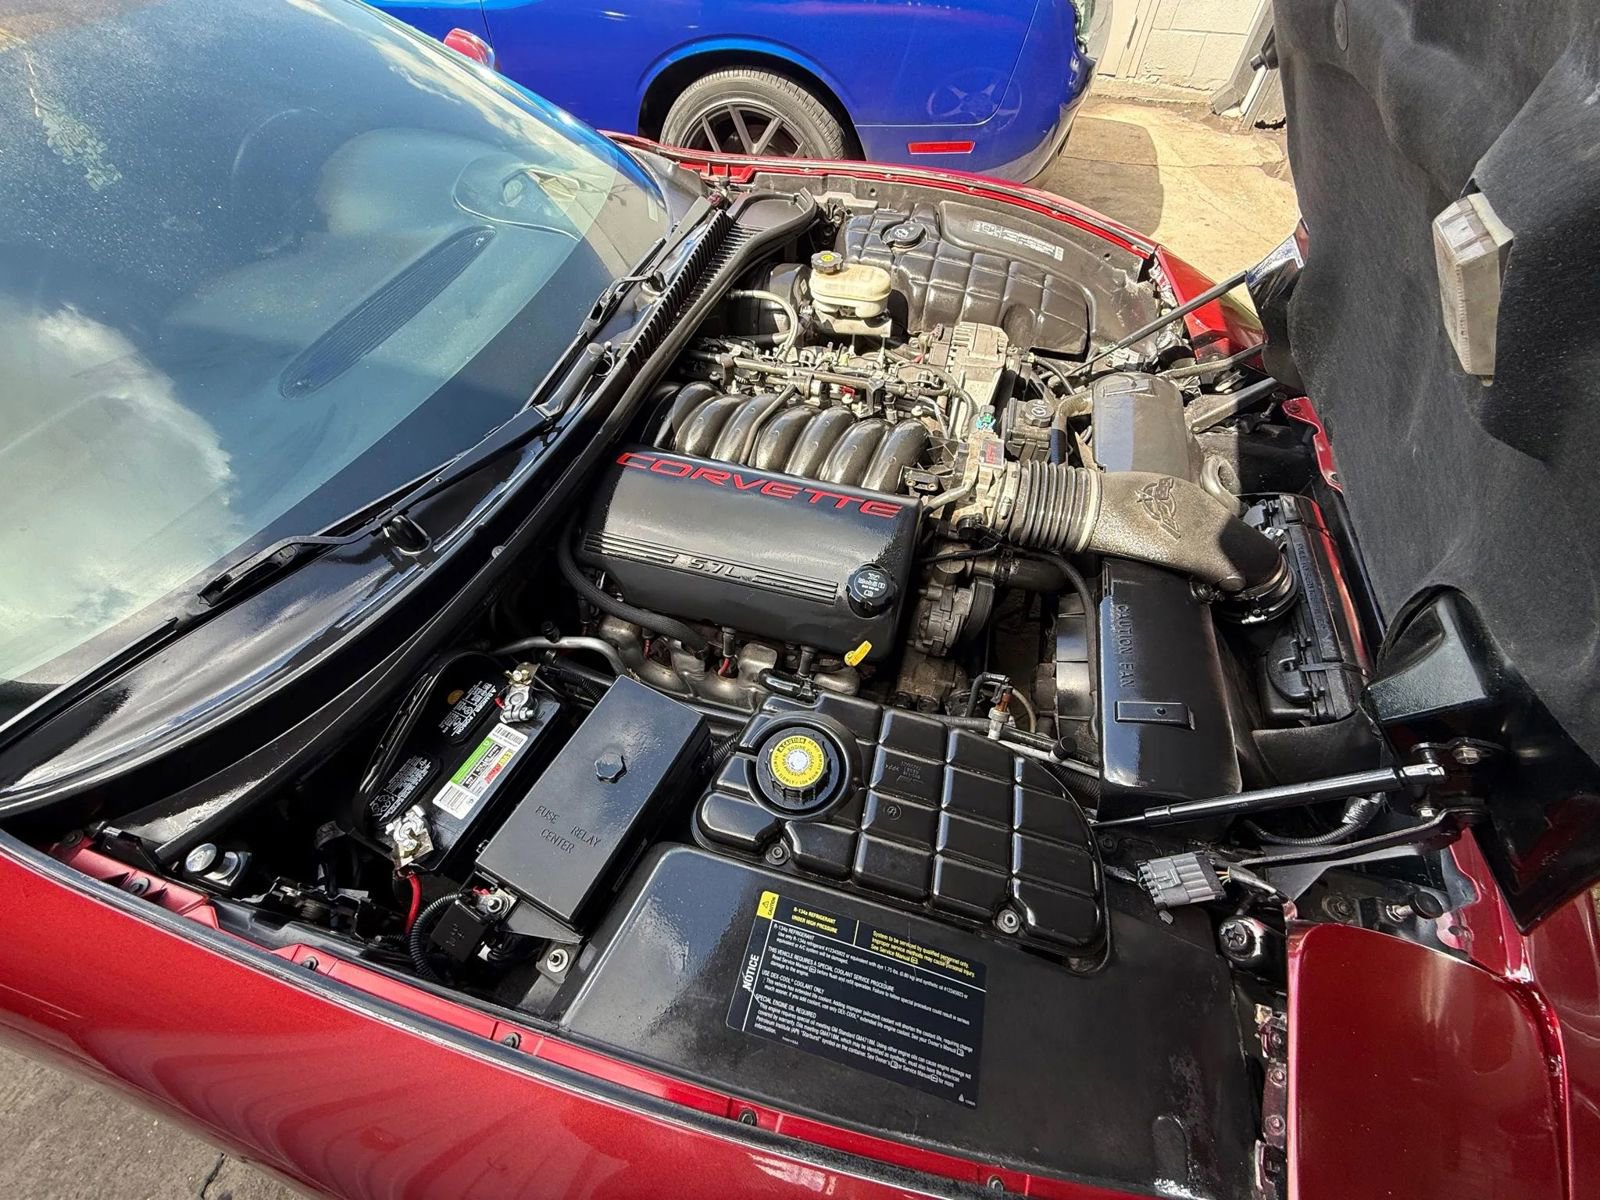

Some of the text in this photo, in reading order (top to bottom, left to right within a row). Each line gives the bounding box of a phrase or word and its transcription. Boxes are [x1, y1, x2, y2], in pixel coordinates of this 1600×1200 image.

[615, 452, 903, 519] CORVETTE
[687, 557, 743, 580] 5.7L
[1115, 604, 1136, 689] CAUTION FAN
[535, 805, 602, 848] FUSE RELAY
[540, 828, 575, 854] CENTER
[742, 953, 760, 991] NOTICE
